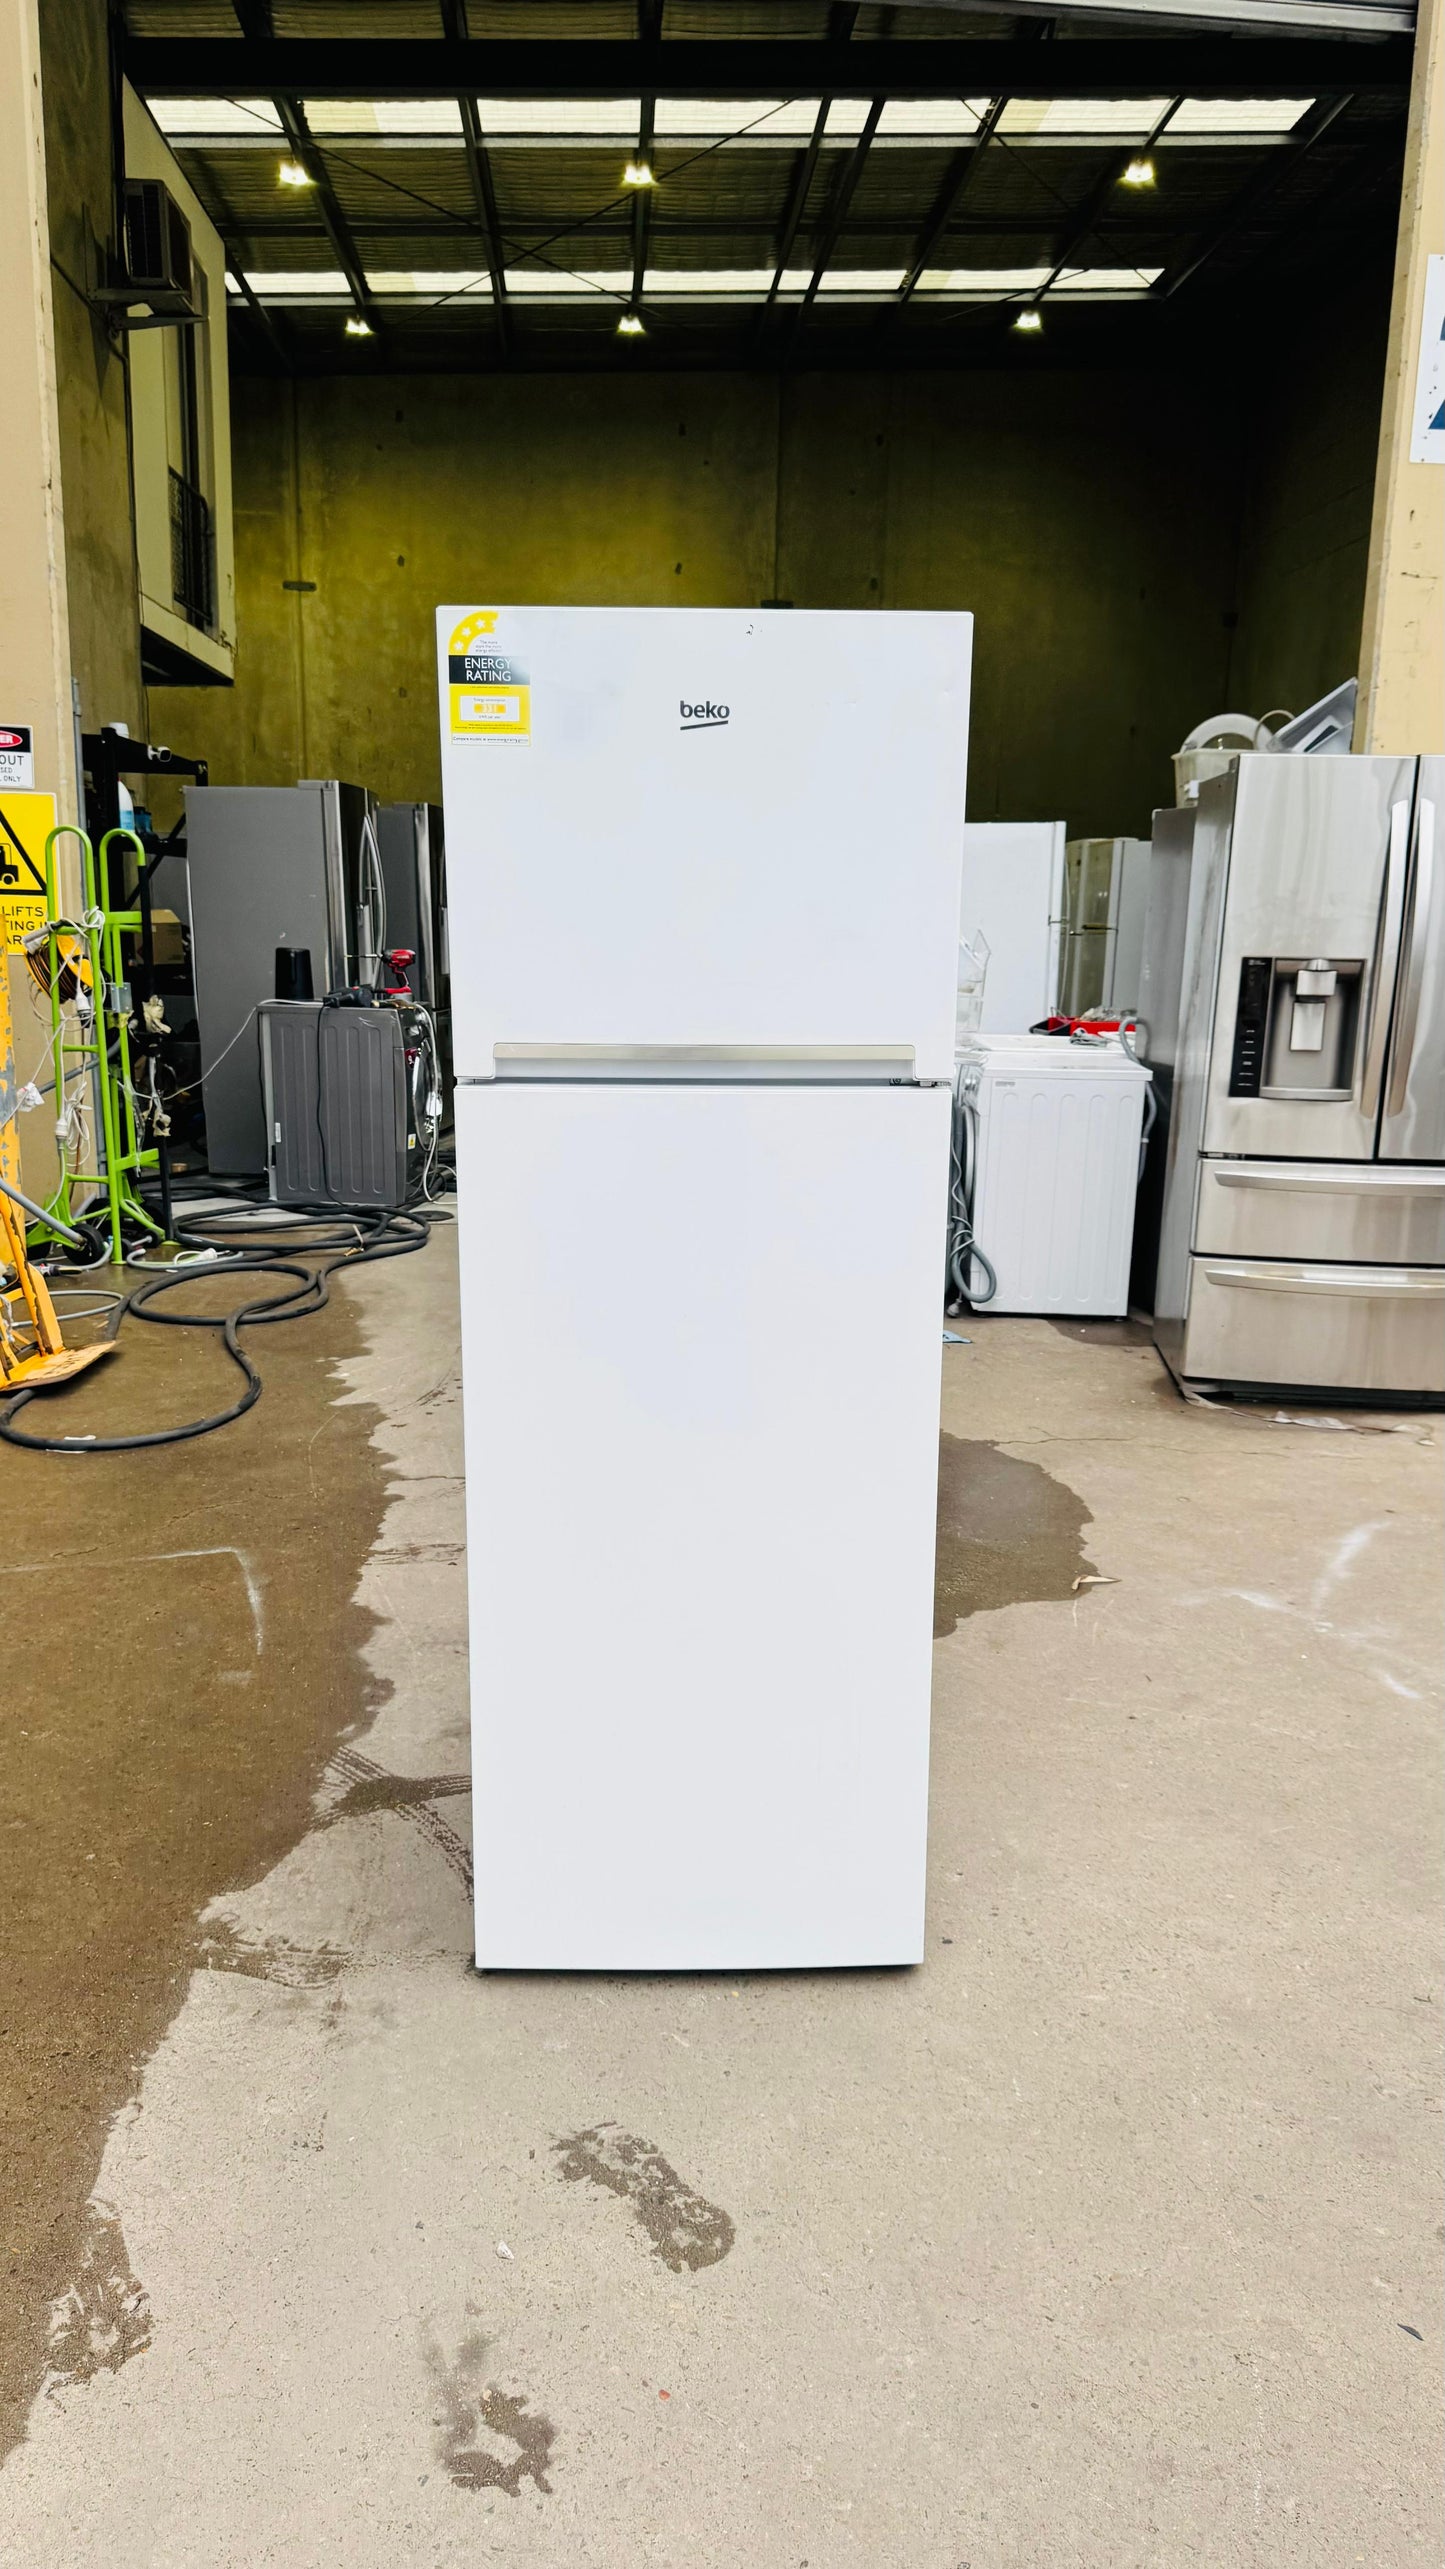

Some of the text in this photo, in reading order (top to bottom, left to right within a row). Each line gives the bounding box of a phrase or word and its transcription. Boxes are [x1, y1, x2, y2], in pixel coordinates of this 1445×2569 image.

[464, 657, 512, 669] ENERGY
[466, 670, 512, 682] RATING
[680, 700, 730, 719] beko
[0, 754, 24, 766] OUT
[2, 906, 44, 917] LIFTS
